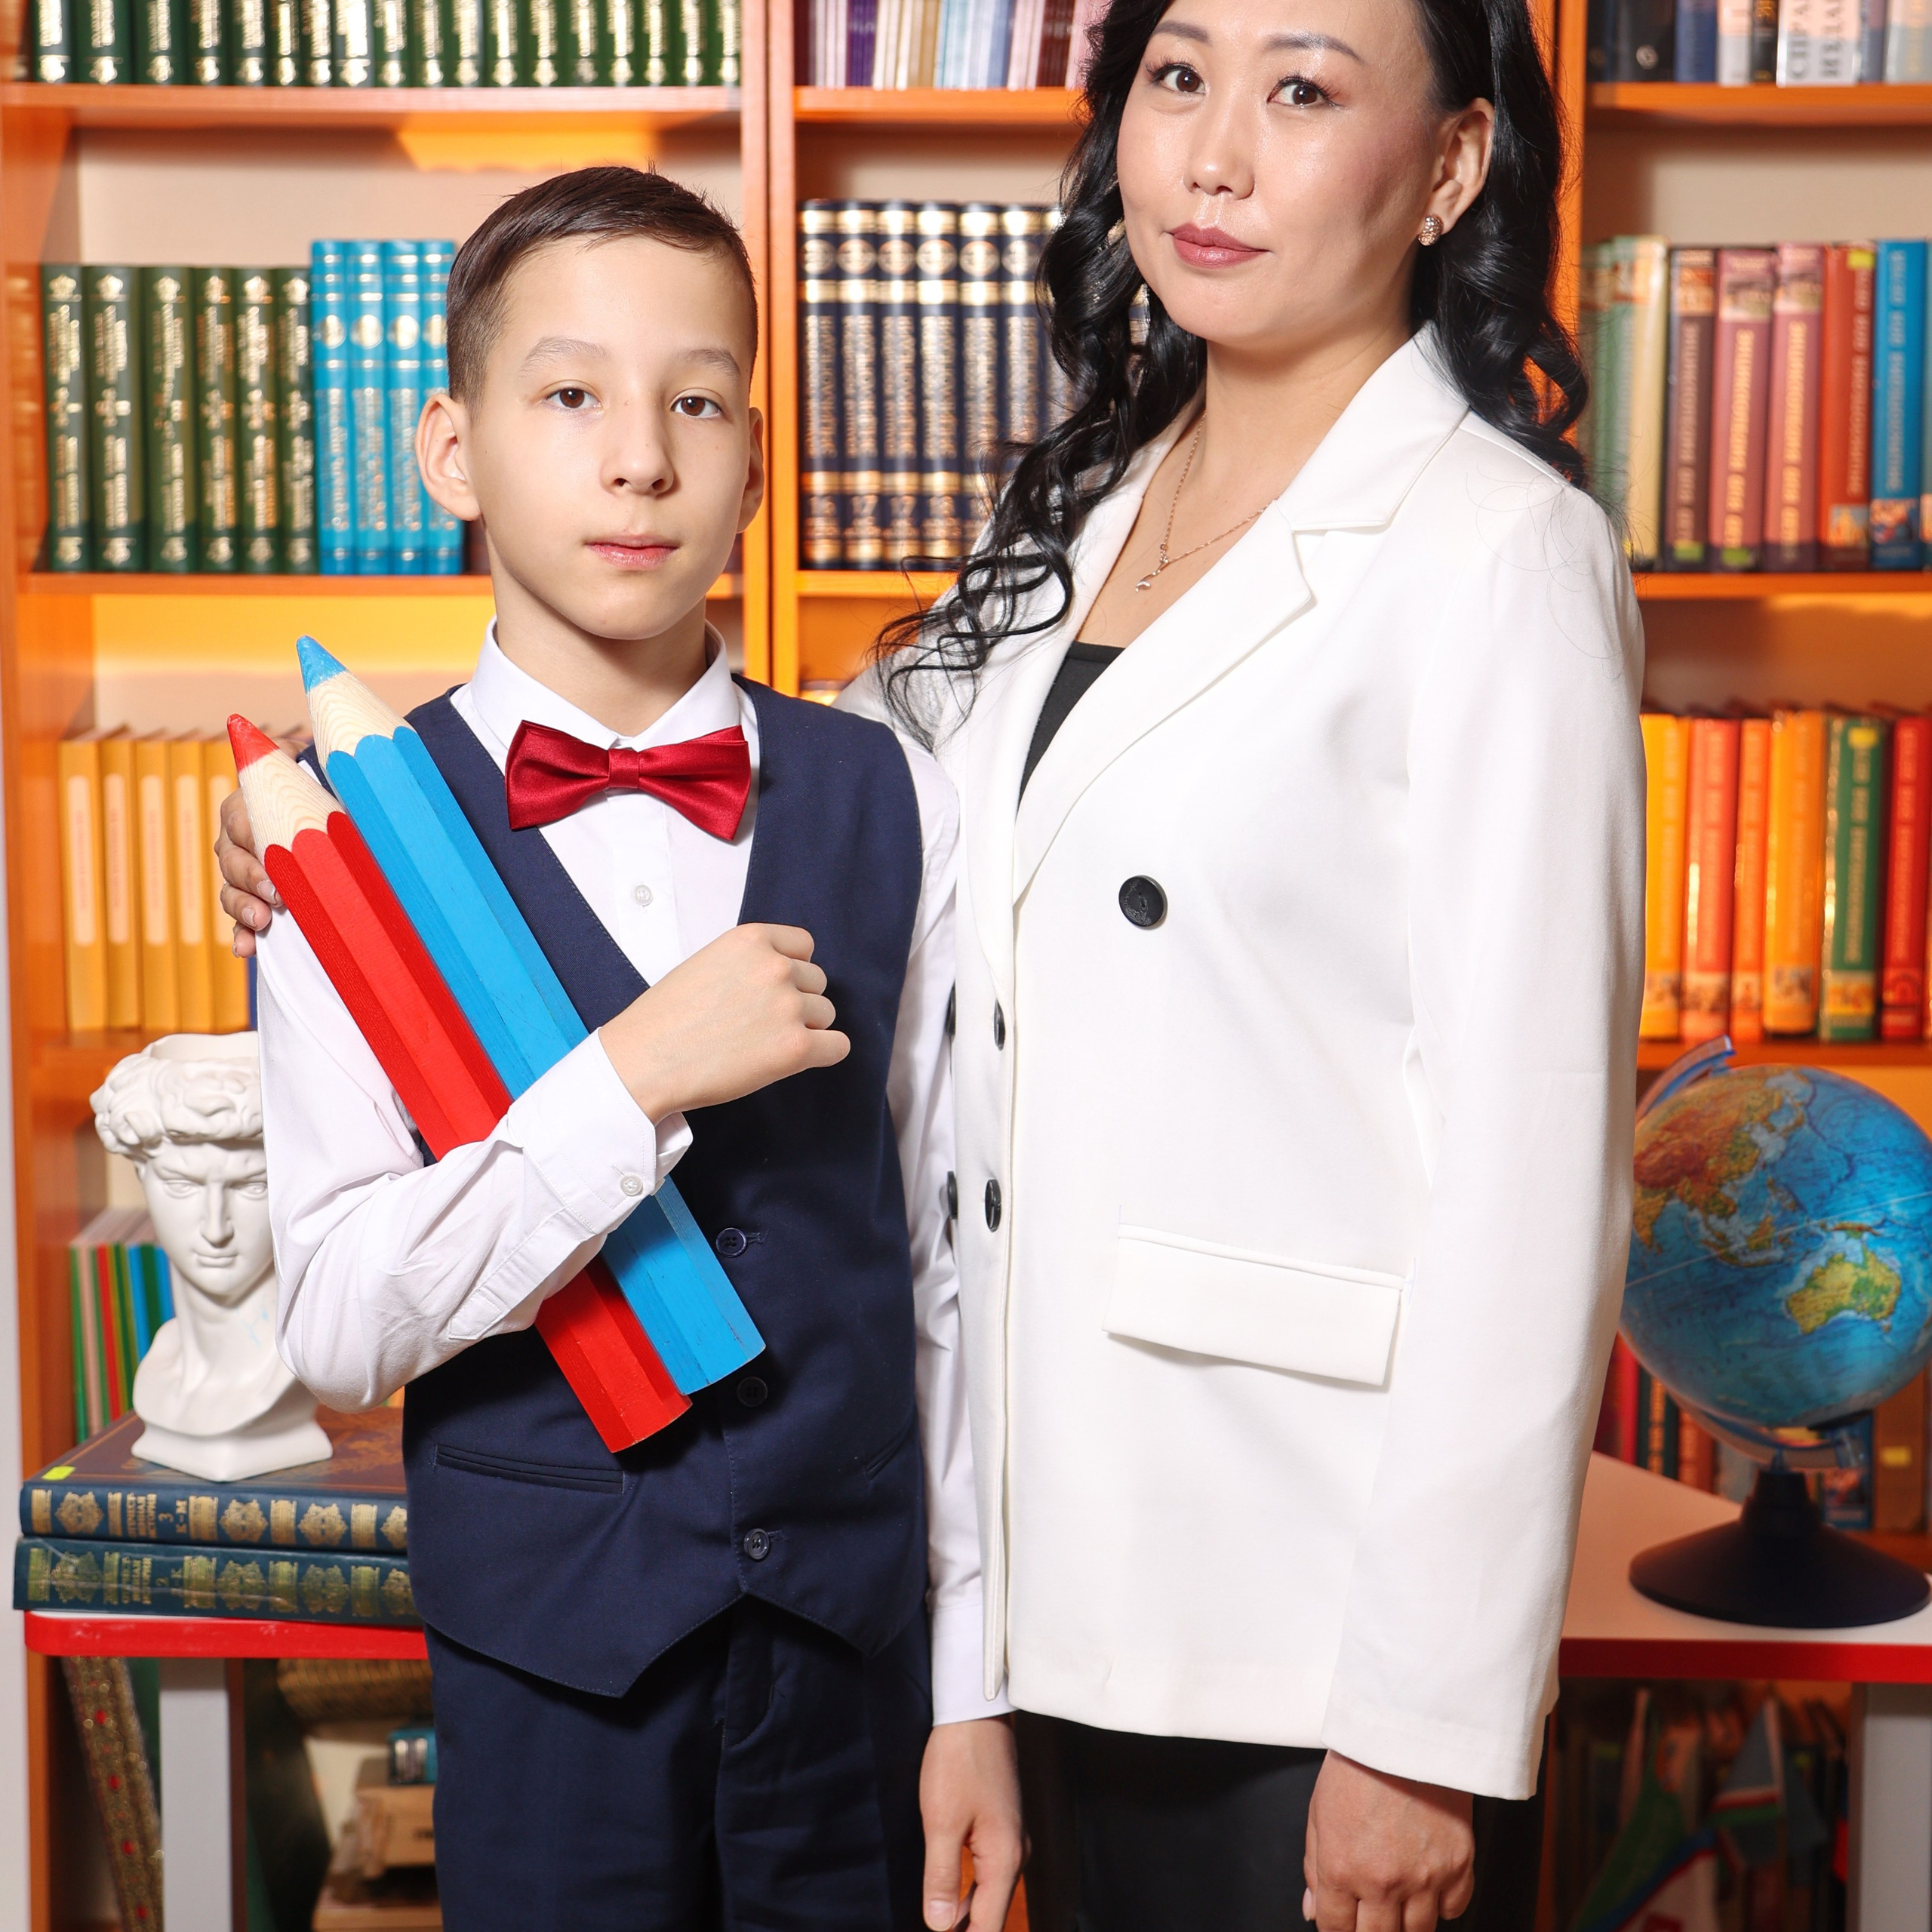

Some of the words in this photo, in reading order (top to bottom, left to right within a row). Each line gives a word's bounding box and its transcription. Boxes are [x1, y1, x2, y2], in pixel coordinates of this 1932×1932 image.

[1787, 0, 1810, 79] СПРА
[1820, 0, 1844, 78] ИЗДА
[158, 1512, 174, 1523] 3
